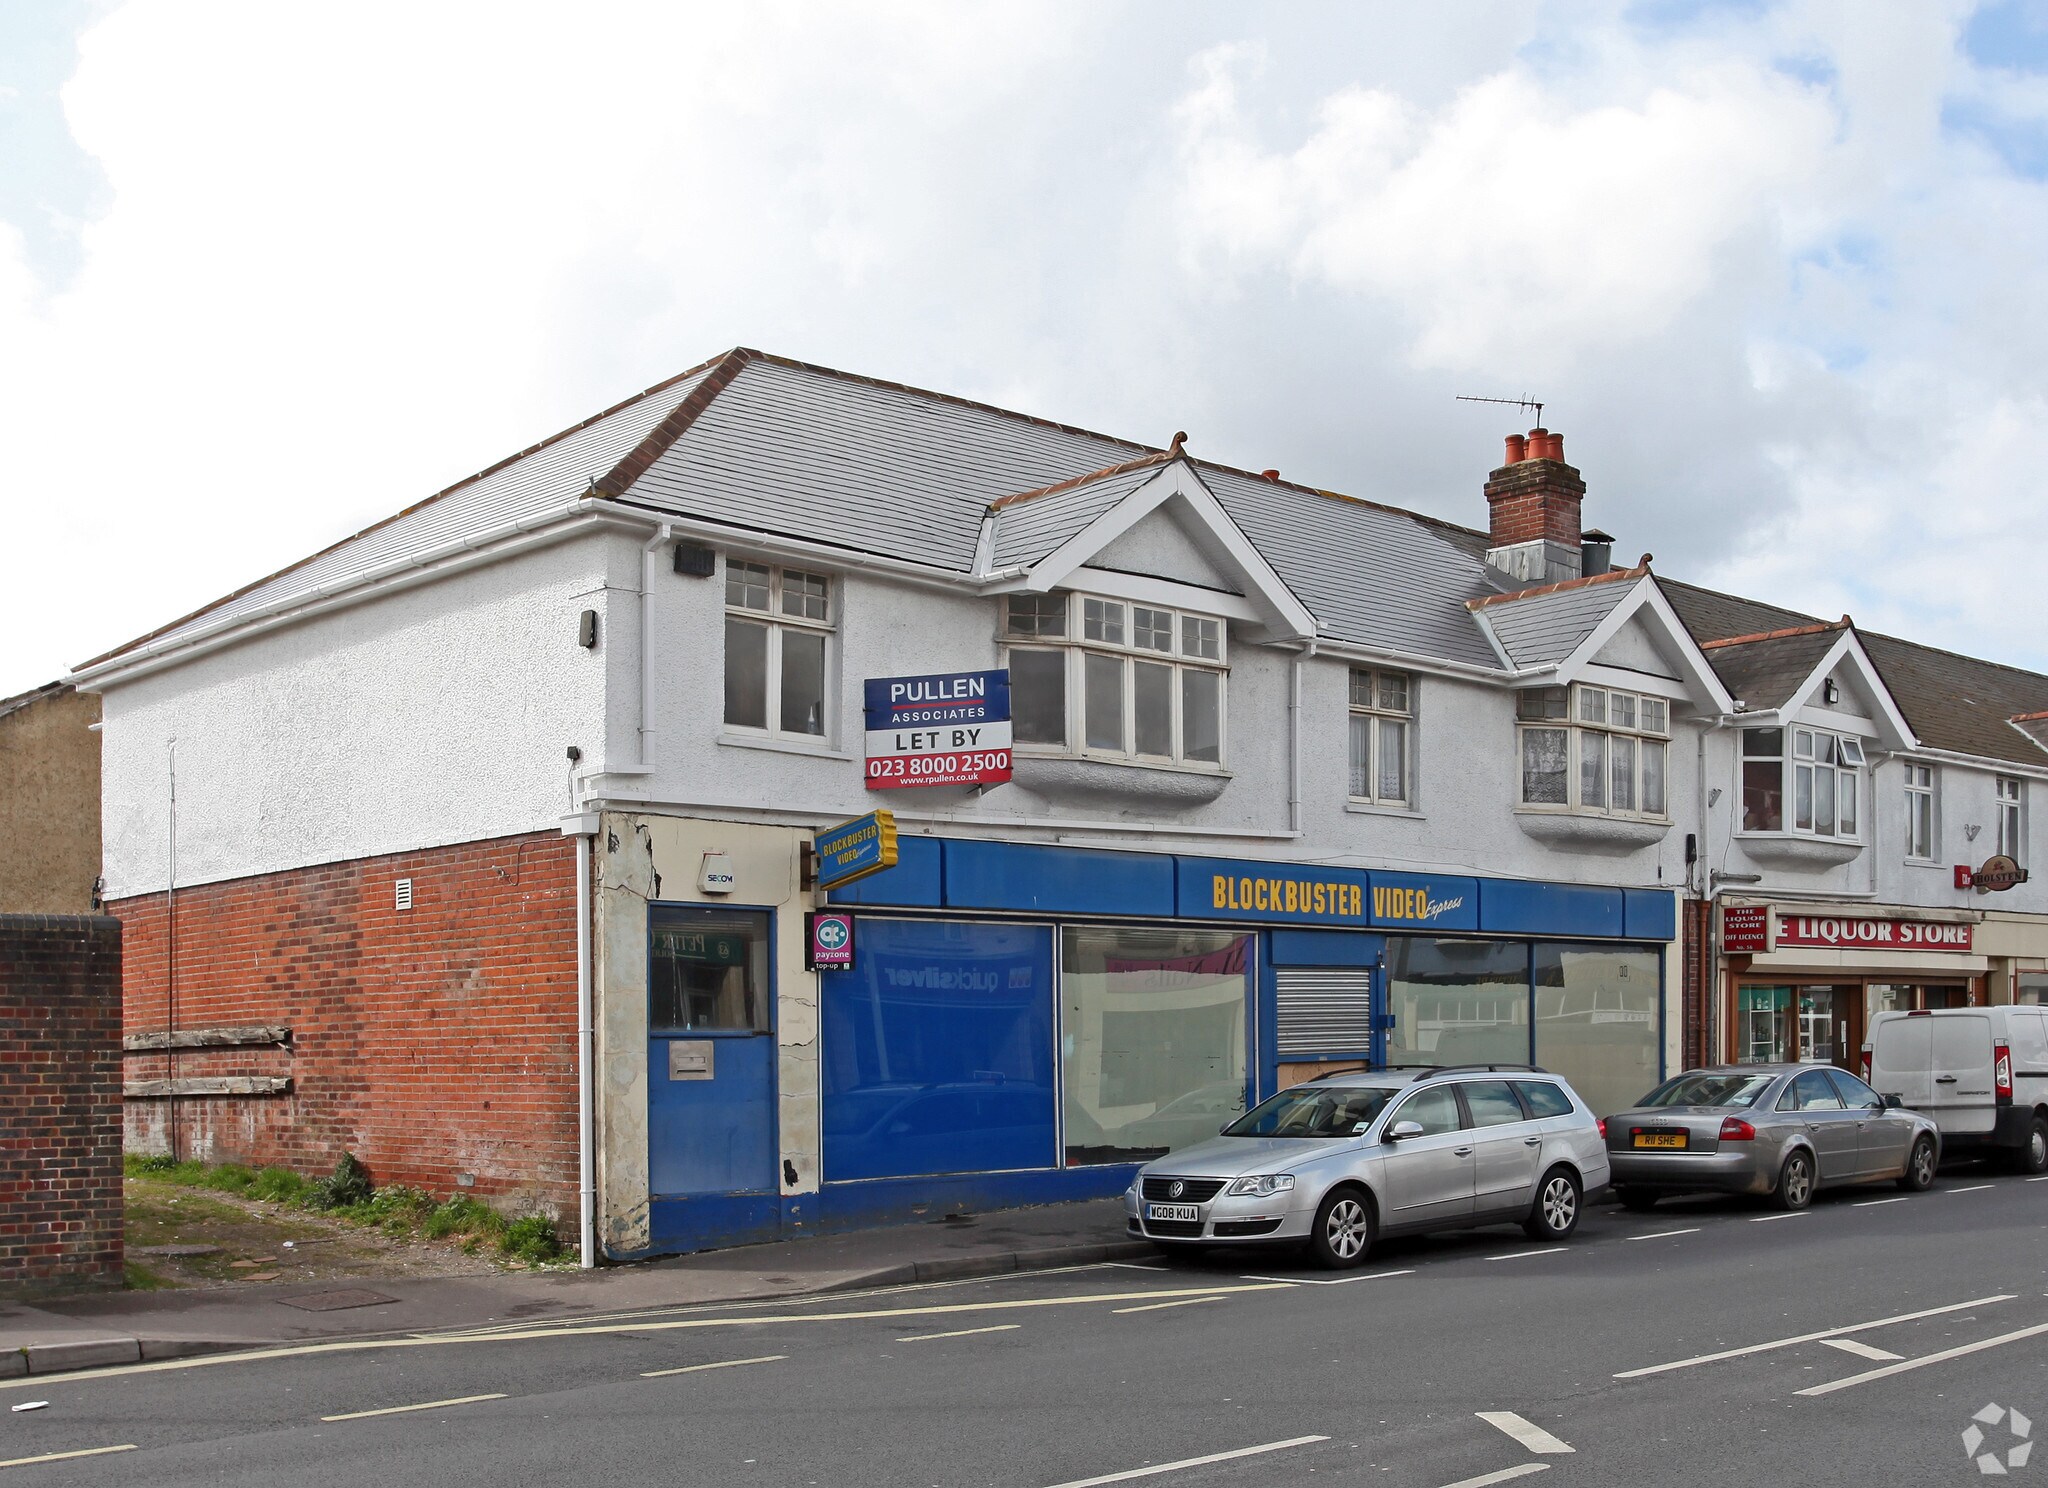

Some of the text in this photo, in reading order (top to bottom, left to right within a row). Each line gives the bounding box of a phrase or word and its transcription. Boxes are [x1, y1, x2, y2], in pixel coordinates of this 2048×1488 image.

[891, 677, 985, 703] PULLEN
[892, 707, 985, 723] ASSOCIATES
[896, 728, 981, 751] LET BY
[870, 752, 1008, 777] 023 8000 2500
[900, 773, 979, 785] www.rpullen.co.uk
[823, 825, 877, 857] BLOCKBUSTER
[837, 849, 857, 865] VIDEO
[707, 874, 733, 882] SECOM
[1977, 871, 2021, 883] HOLSTEN
[1213, 875, 1361, 916] BLOCKBUSTER
[1373, 886, 1463, 920] VIDEO Express
[1798, 918, 1892, 943] LIQUOR
[1900, 923, 1968, 944] STORE
[816, 951, 850, 960] payzone
[1658, 1135, 1675, 1145] SHE
[1151, 1206, 1196, 1220] WG08 KUA
